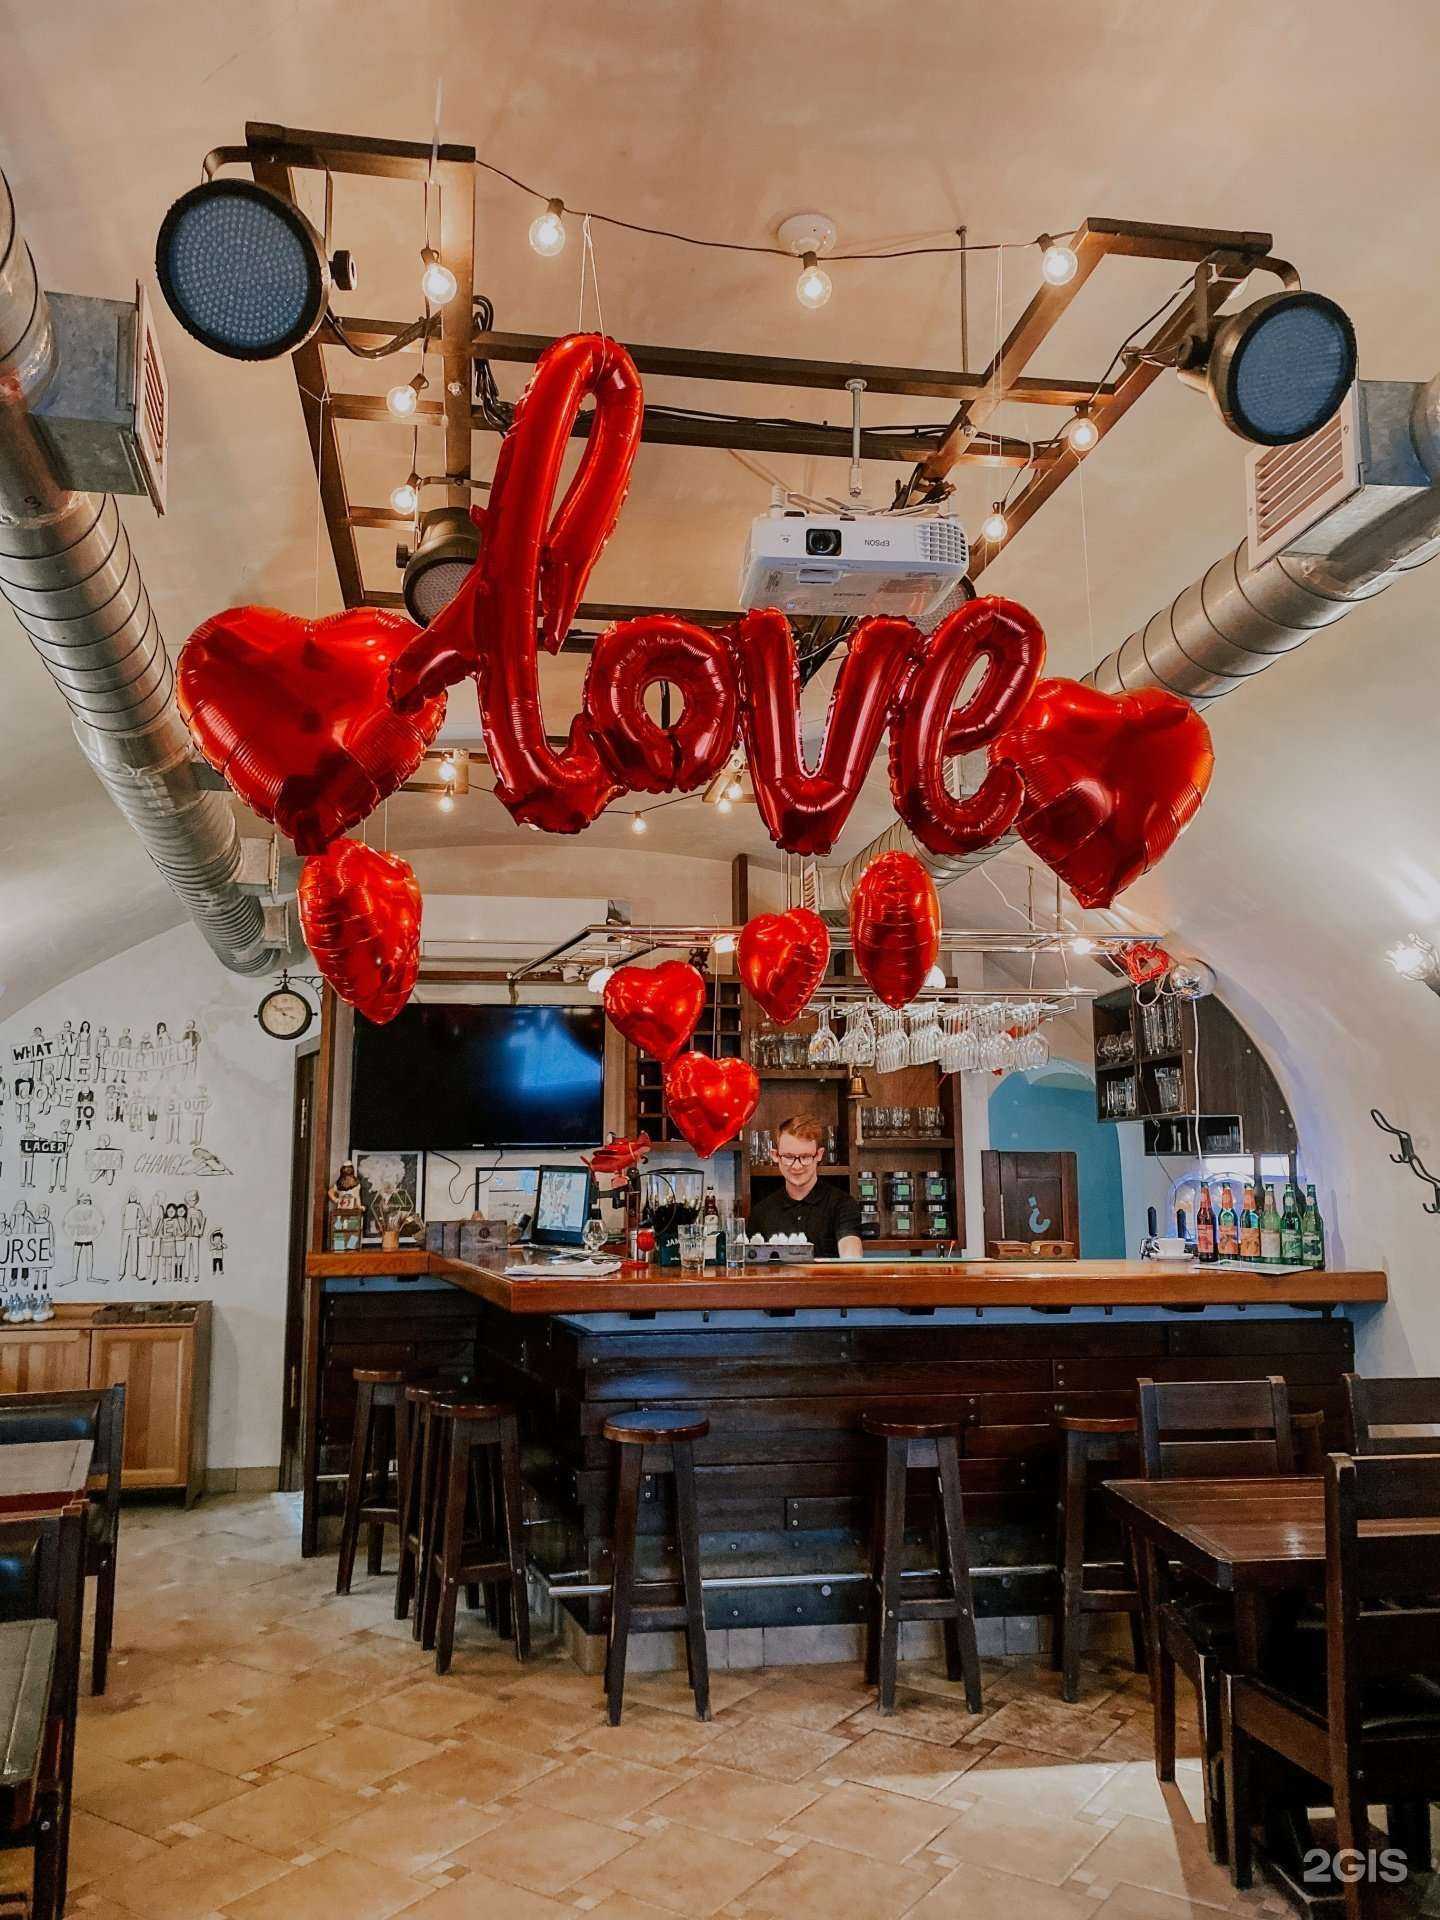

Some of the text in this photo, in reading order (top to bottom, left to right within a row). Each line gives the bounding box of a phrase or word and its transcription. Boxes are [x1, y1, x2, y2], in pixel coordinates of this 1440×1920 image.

[864, 539, 891, 548] EPSON
[13, 1041, 53, 1061] WHAT
[76, 1105, 95, 1119] TO
